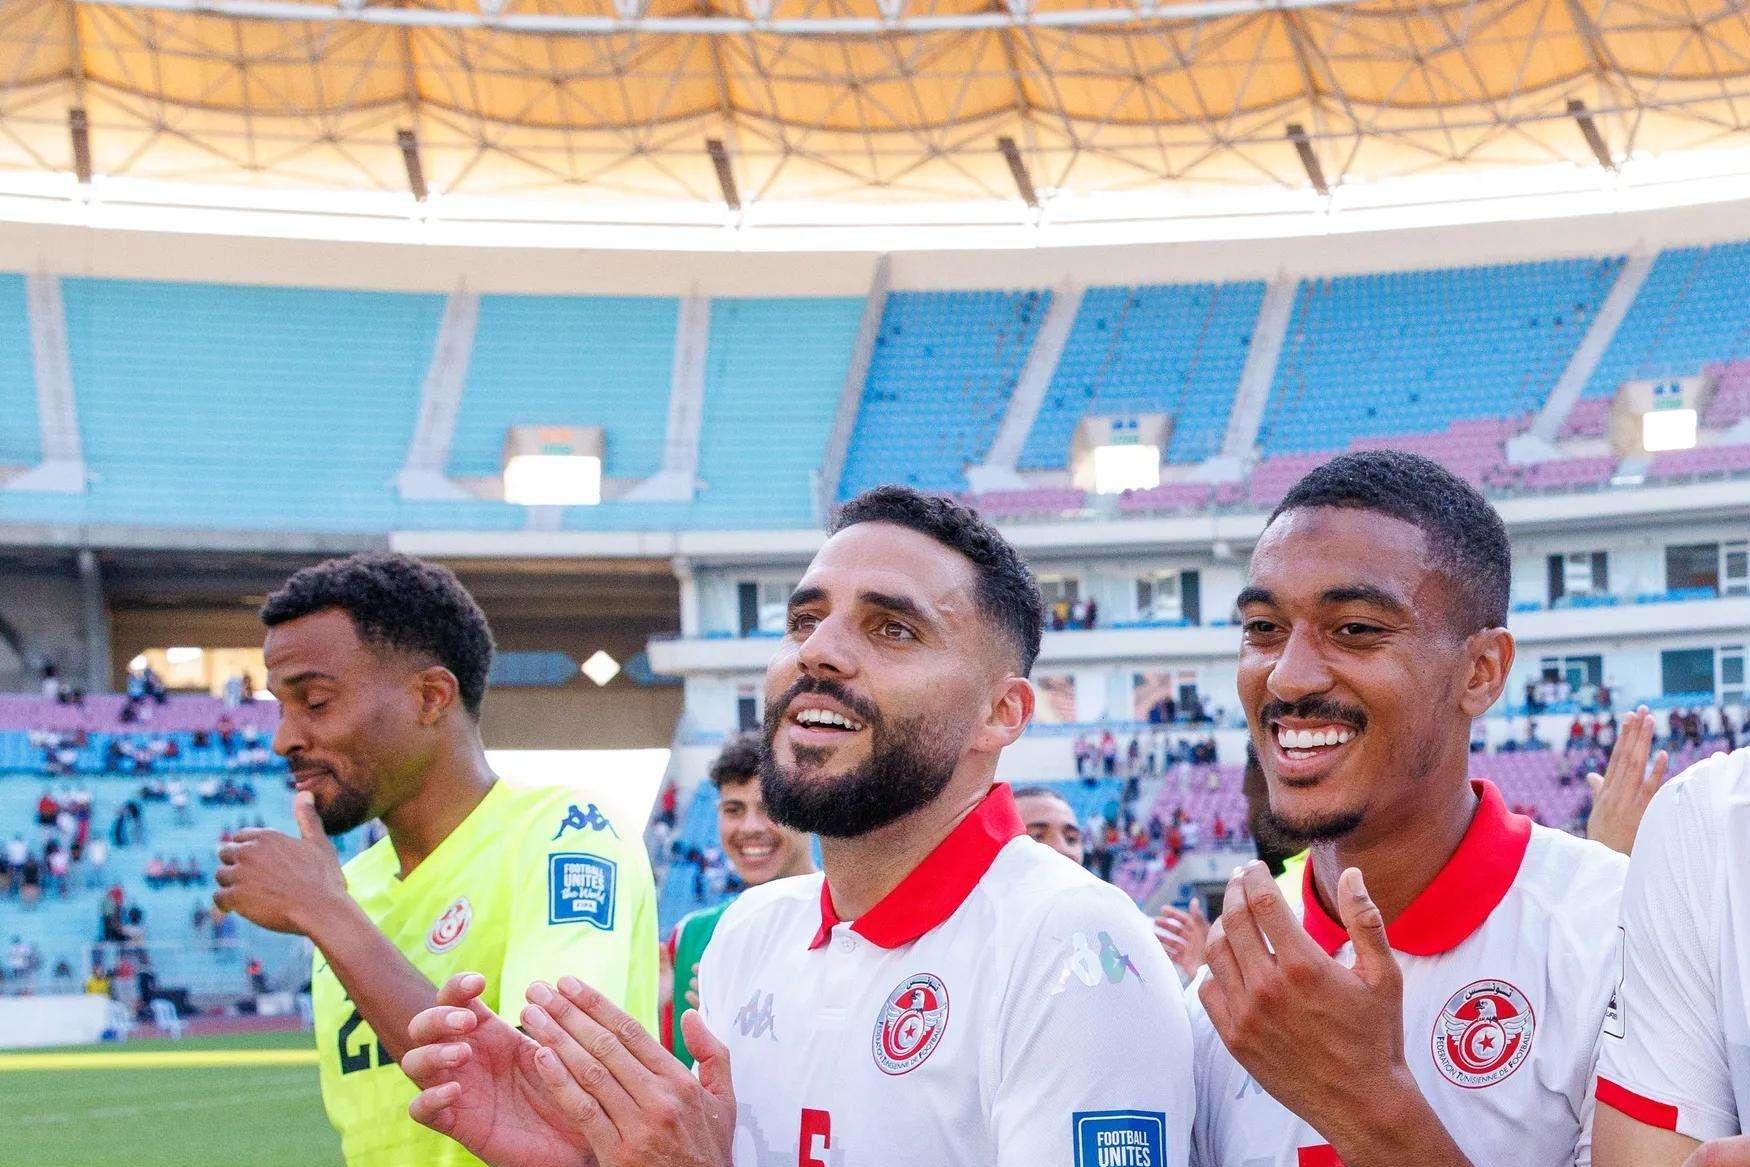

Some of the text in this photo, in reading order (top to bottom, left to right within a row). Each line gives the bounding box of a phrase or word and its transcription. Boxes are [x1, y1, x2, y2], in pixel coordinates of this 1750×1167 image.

[1437, 1036, 1456, 1076] FEDERATION
[1096, 1130, 1149, 1146] FOOTBALL
[1098, 1146, 1151, 1167] UNITES
